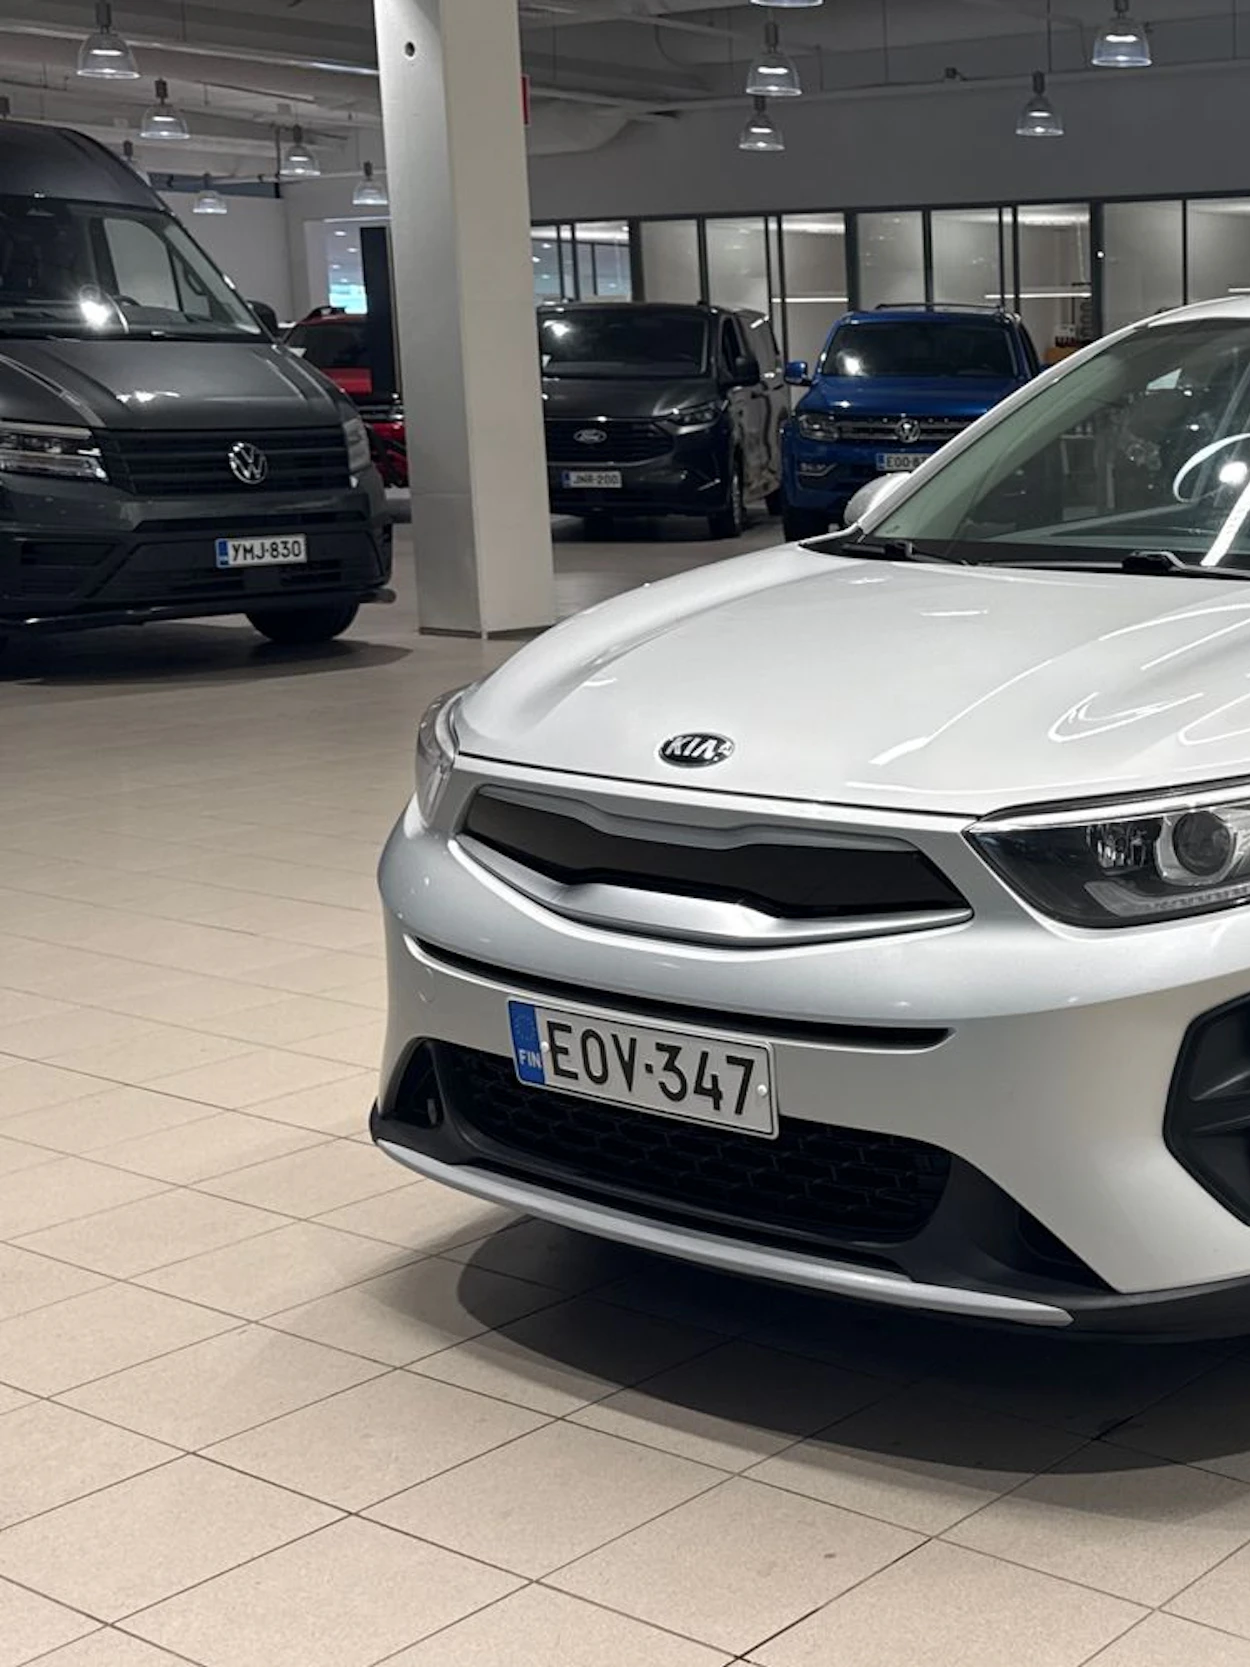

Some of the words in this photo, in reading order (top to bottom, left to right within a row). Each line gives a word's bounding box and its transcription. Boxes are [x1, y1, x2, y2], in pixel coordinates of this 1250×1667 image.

[232, 540, 301, 561] YMJ-830
[664, 736, 718, 760] KIA
[519, 1049, 542, 1069] FIN
[547, 1020, 755, 1115] EOV-347
